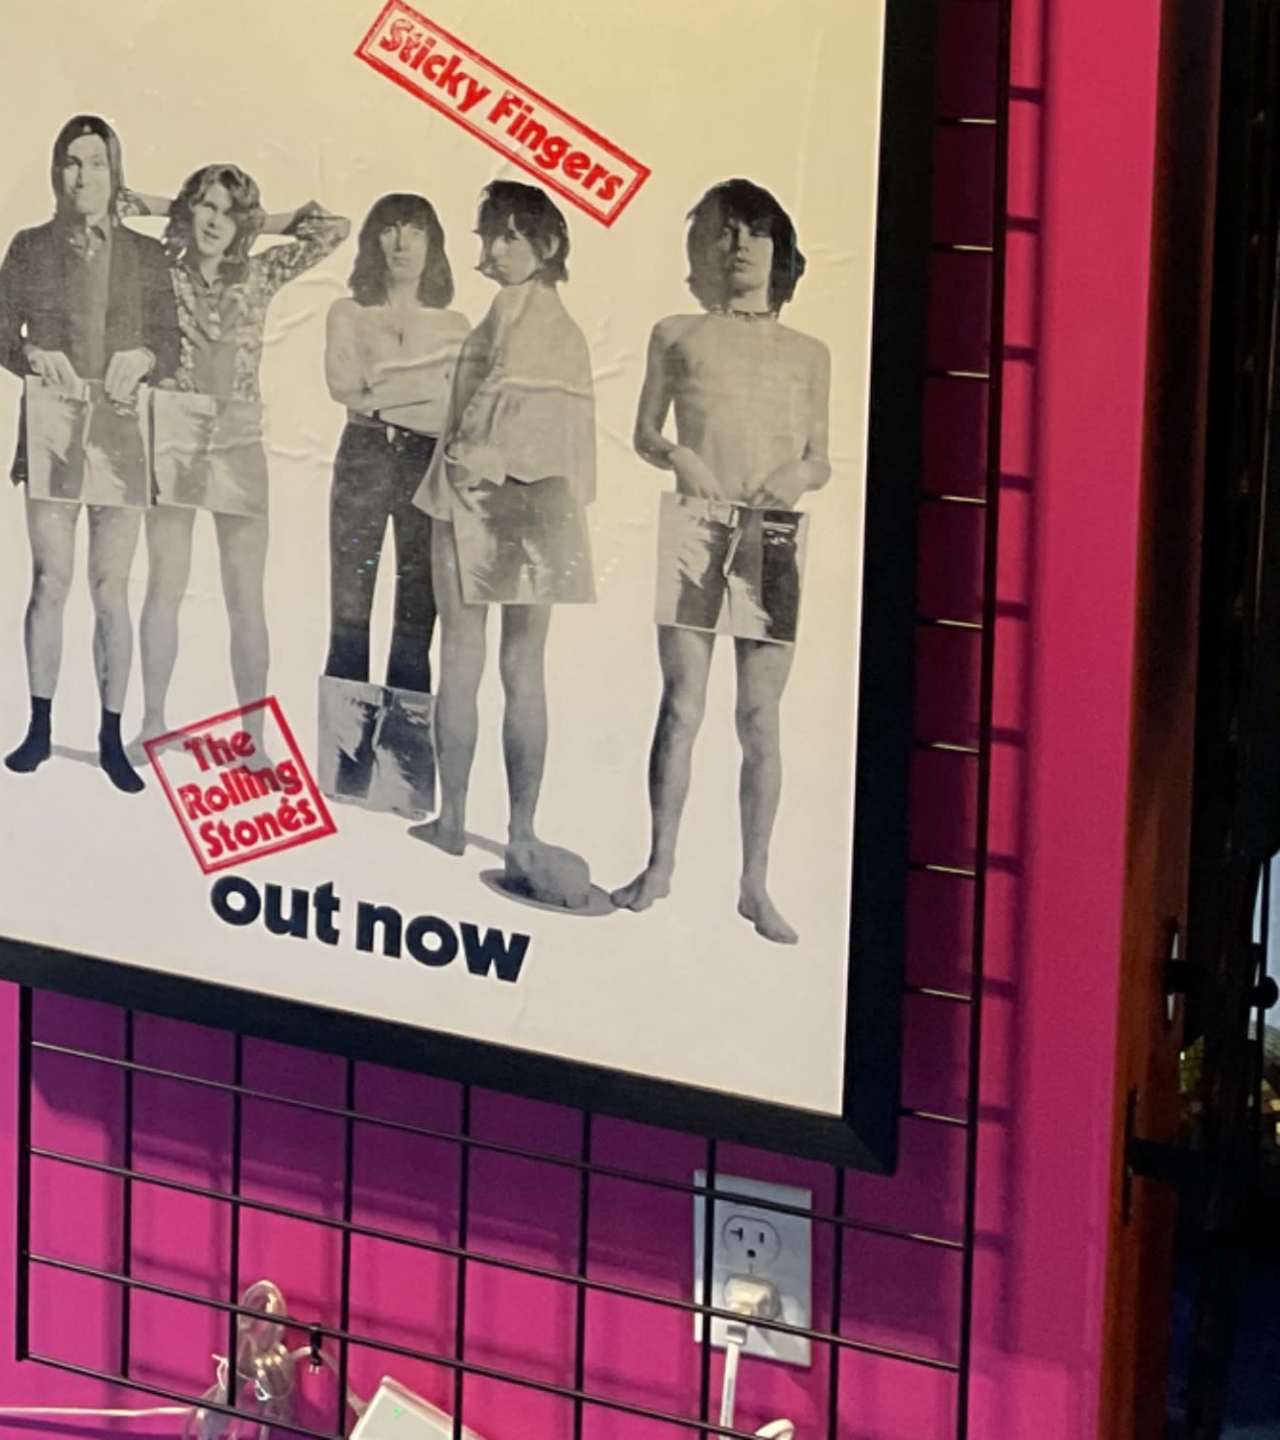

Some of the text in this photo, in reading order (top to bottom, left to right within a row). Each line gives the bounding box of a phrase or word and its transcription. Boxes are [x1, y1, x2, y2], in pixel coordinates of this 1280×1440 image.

[379, 18, 624, 201] Sticky Fingers
[182, 730, 257, 773] The
[177, 760, 303, 821] Rolling
[199, 797, 318, 858] Stones
[210, 875, 531, 984] out now
